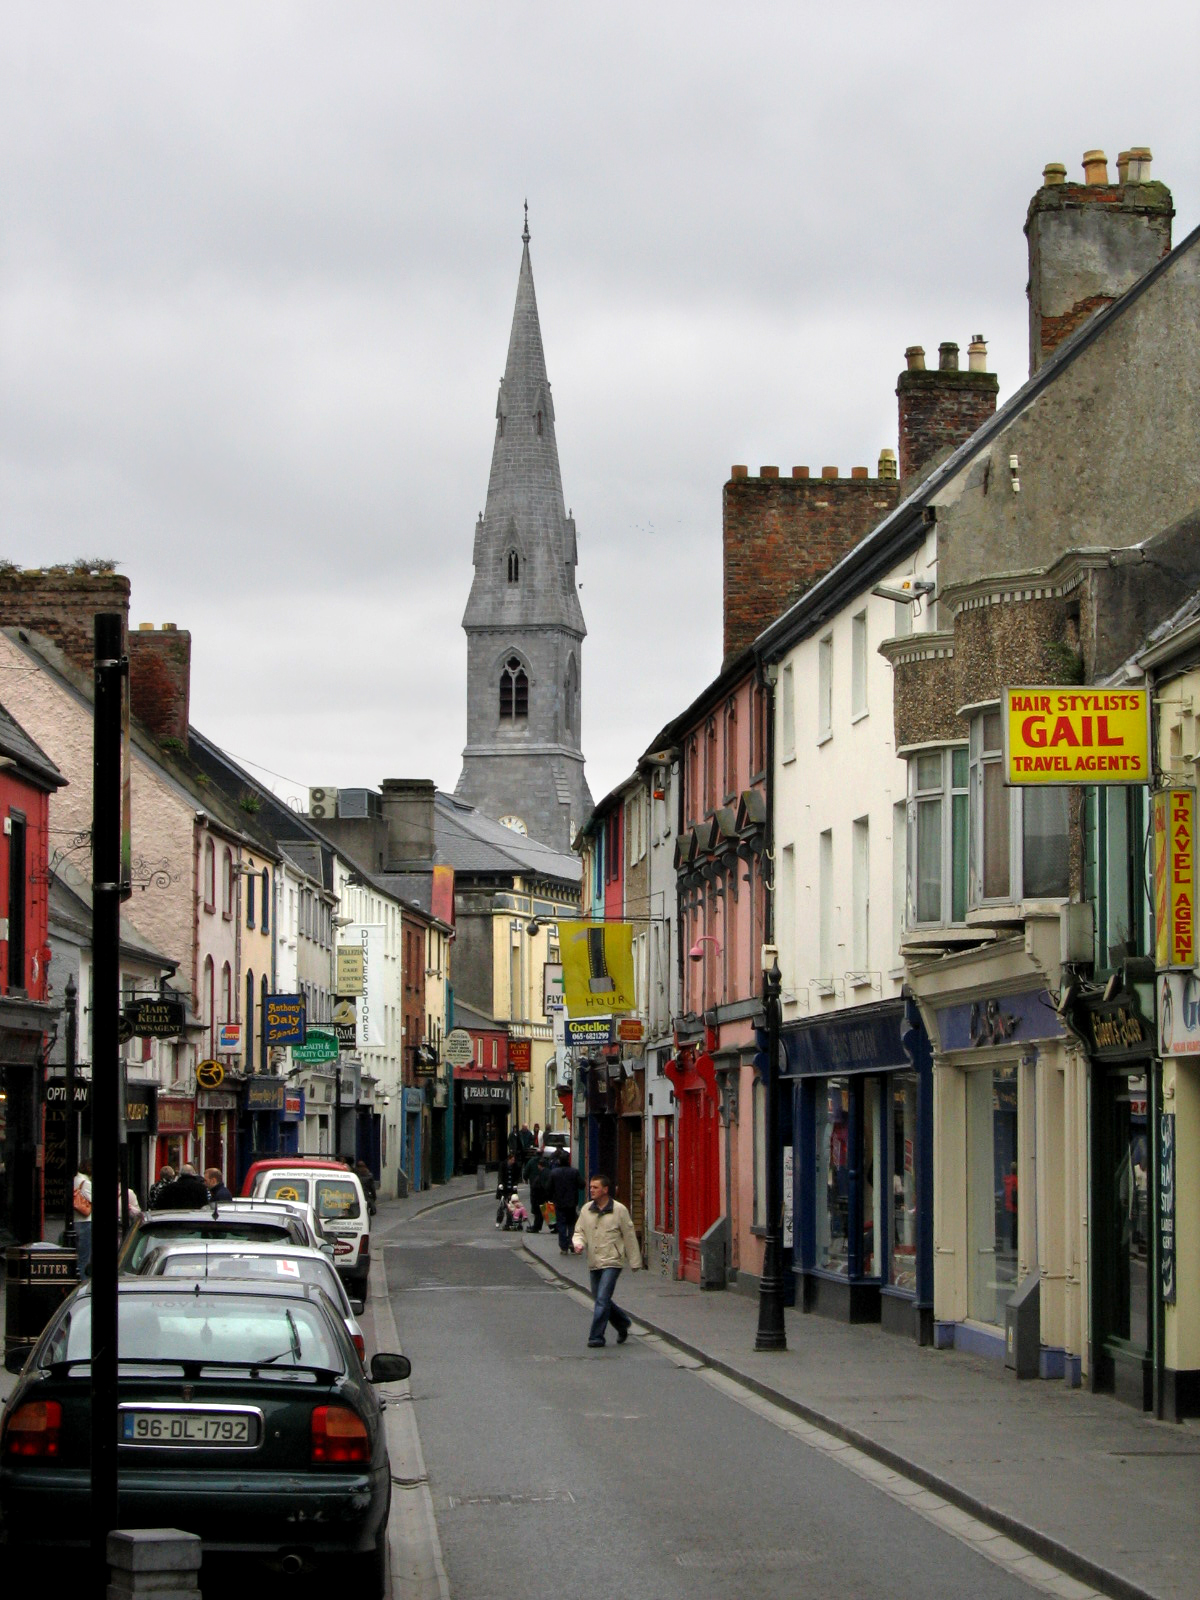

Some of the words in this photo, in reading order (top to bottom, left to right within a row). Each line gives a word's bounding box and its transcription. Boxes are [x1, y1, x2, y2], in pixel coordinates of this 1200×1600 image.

[1011, 696, 1053, 715] HAIR
[1057, 695, 1140, 712] STYLISTS
[1021, 715, 1124, 748] GAIL
[1013, 756, 1072, 772] TRAVEL
[1074, 755, 1141, 771] AGENTS
[1173, 793, 1191, 884] TRAVEL
[1174, 893, 1192, 963] AGENT
[361, 929, 369, 984] DUNNES
[585, 995, 625, 1007] HOUR
[140, 1004, 170, 1014] MARY
[267, 1003, 301, 1014] Anthony
[362, 986, 370, 1042] STORES
[137, 1013, 171, 1023] KELLY
[267, 1014, 300, 1026] Daly
[135, 1024, 181, 1032] EWSAGENT
[568, 1021, 611, 1033] Costelloe
[268, 1027, 300, 1040] Sports
[324, 1042, 330, 1050] &
[292, 1050, 316, 1058] BEAUTY
[317, 1049, 338, 1058] CLINIC
[469, 1086, 489, 1098] PEARL
[490, 1086, 505, 1098] CITY
[30, 1264, 68, 1275] LITTER
[282, 1259, 295, 1272] L
[136, 1418, 247, 1440] 96-DL-1792
